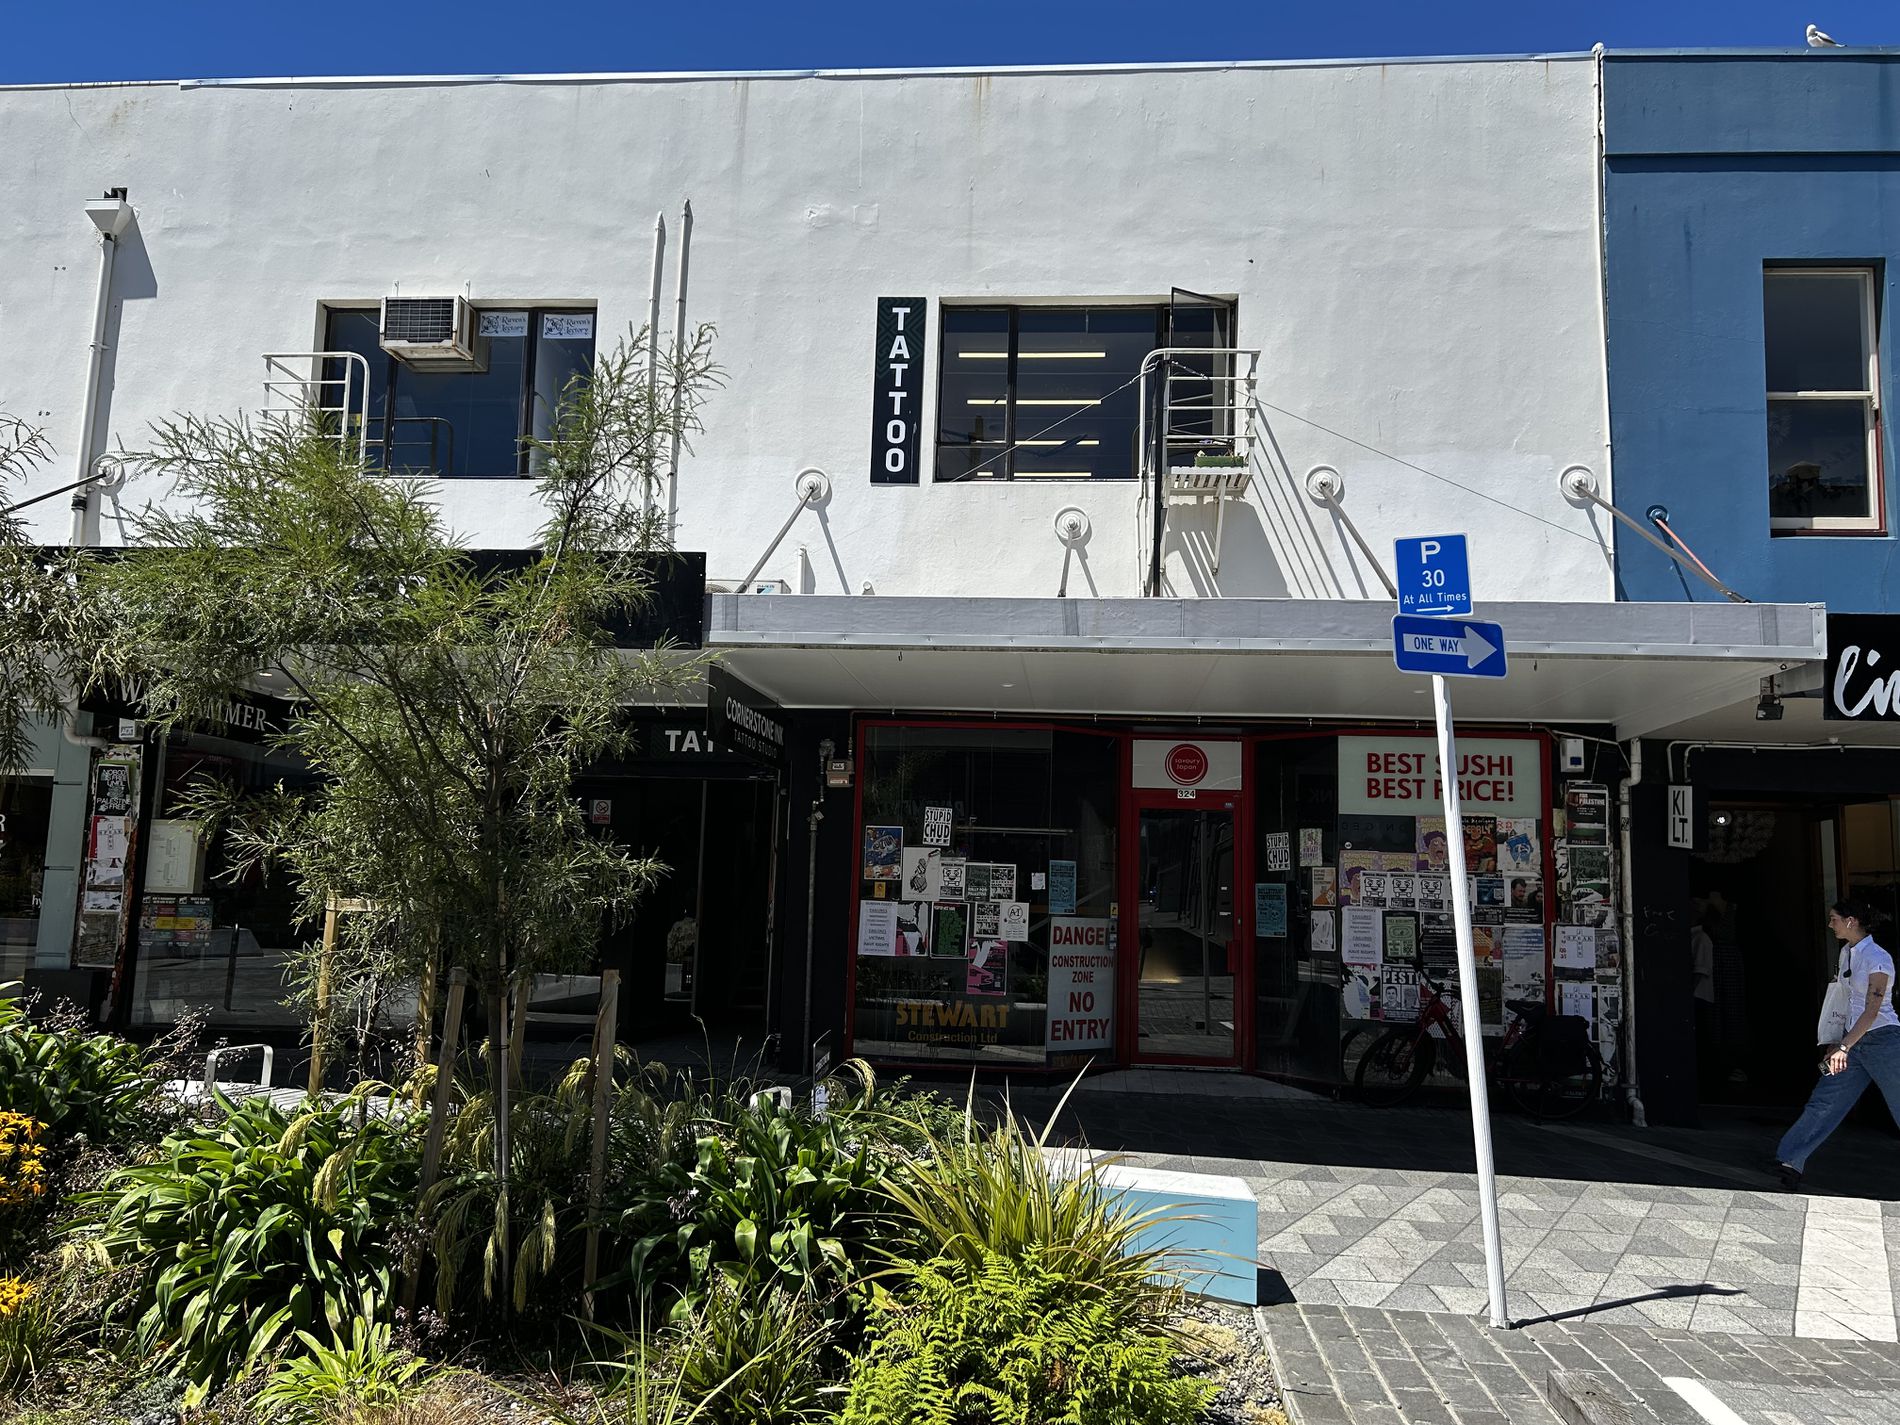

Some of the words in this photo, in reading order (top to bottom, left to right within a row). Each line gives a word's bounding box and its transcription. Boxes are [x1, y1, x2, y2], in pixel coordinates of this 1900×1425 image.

[885, 307, 911, 472] TATTOO
[1420, 541, 1441, 564] P
[1422, 569, 1445, 588] 30
[1403, 595, 1414, 605] At
[1418, 593, 1433, 604] All
[1436, 592, 1467, 602] Times
[1414, 636, 1434, 651] ONE
[1439, 638, 1459, 652] WAY
[726, 696, 774, 741] CORNERSTONE
[734, 728, 757, 750] TATTOO
[1367, 753, 1426, 774] BEST
[1178, 790, 1195, 798] 324
[1367, 778, 1426, 799] BEST
[925, 810, 952, 822] STUPID
[924, 823, 950, 839] CHUD
[1267, 835, 1289, 848] STUPID
[1268, 849, 1289, 864] CHUD
[1052, 955, 1114, 968] CONSTRUCTION
[1072, 971, 1094, 983] ZONE
[1069, 991, 1095, 1012] NO
[896, 1000, 1009, 1028] STEWART
[908, 1030, 977, 1043] Construction
[981, 1032, 998, 1043] Ltd
[1051, 1018, 1110, 1041] ENTRY
